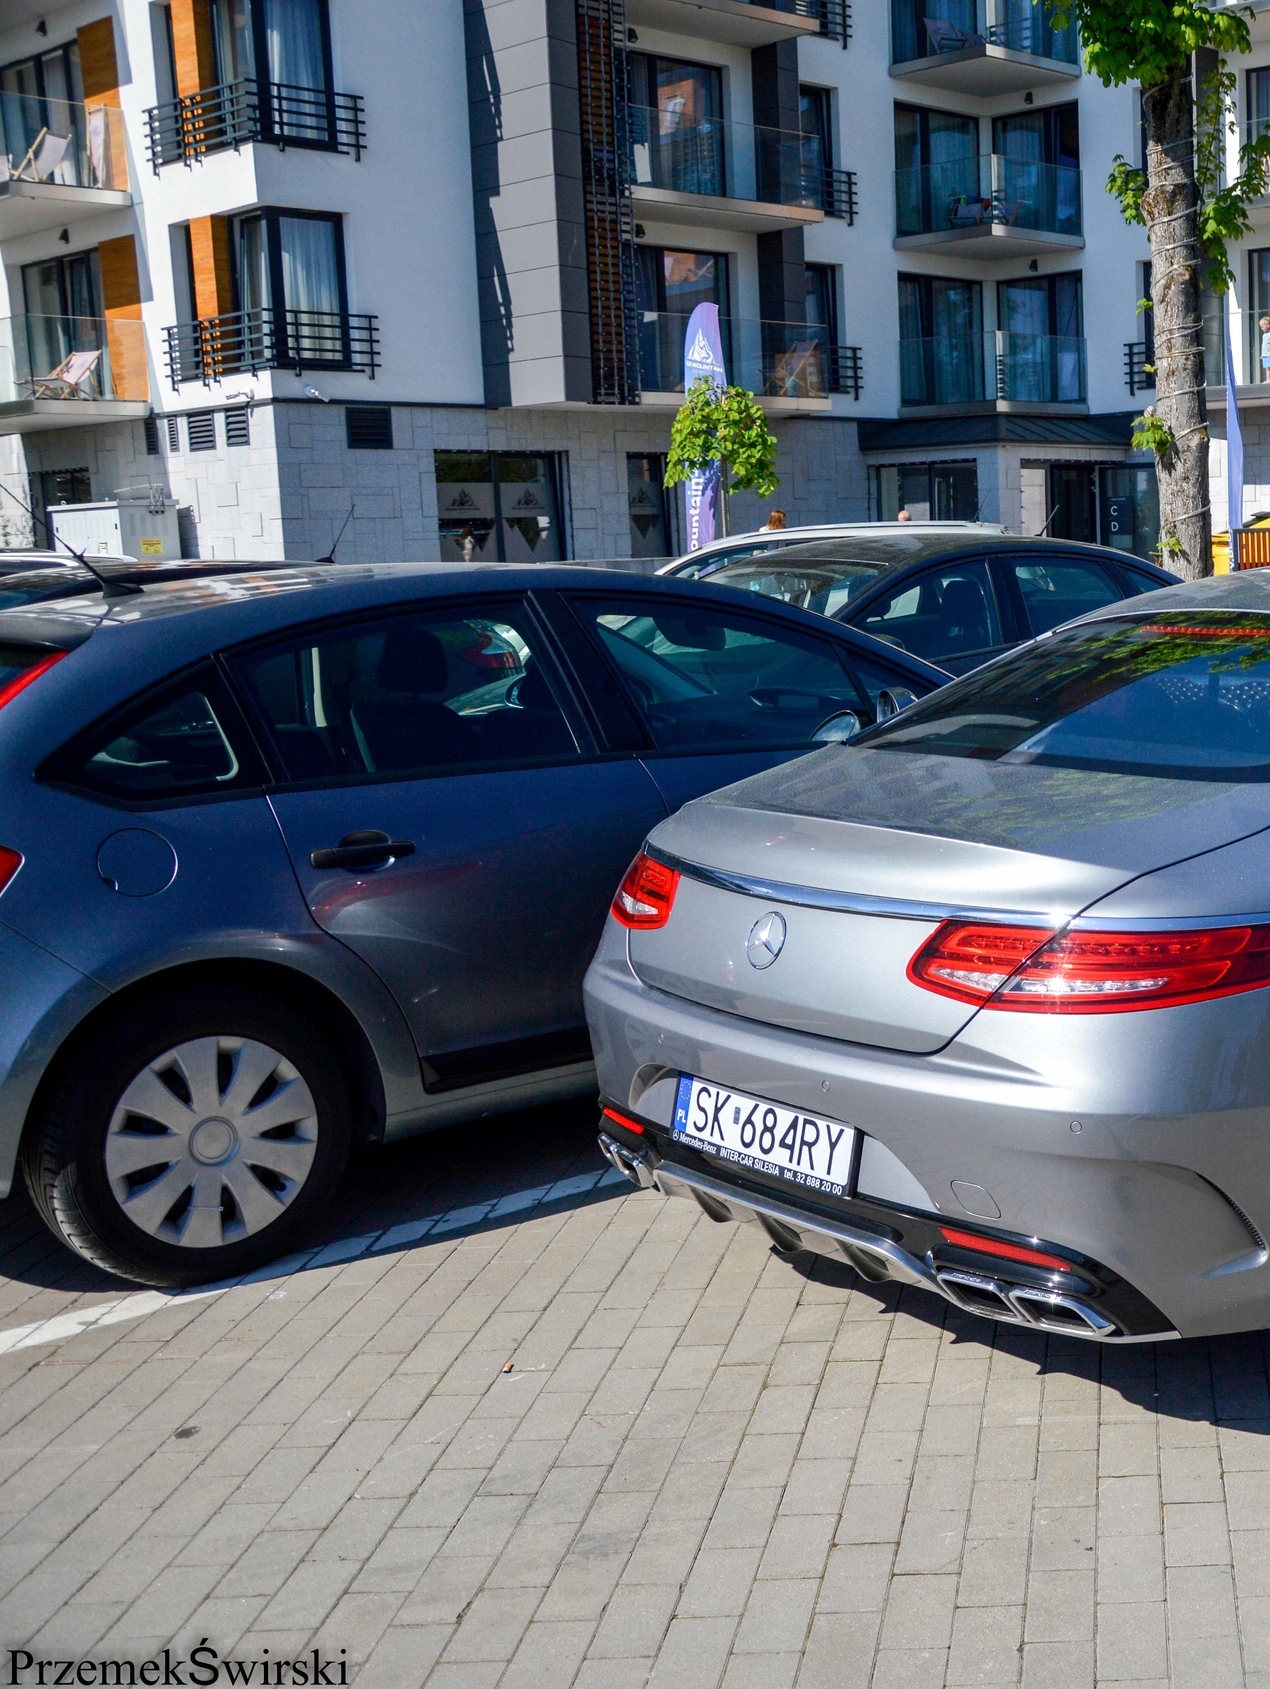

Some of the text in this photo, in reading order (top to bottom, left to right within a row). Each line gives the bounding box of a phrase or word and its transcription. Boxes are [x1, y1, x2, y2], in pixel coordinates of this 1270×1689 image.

[1110, 505, 1118, 516] C
[1111, 521, 1119, 532] D
[676, 1108, 687, 1123] PL
[693, 1086, 845, 1176] SK 684RY
[679, 1132, 843, 1196] Mercedes-Benz INTER-CAR SILESIA tel. 32 888 20 00
